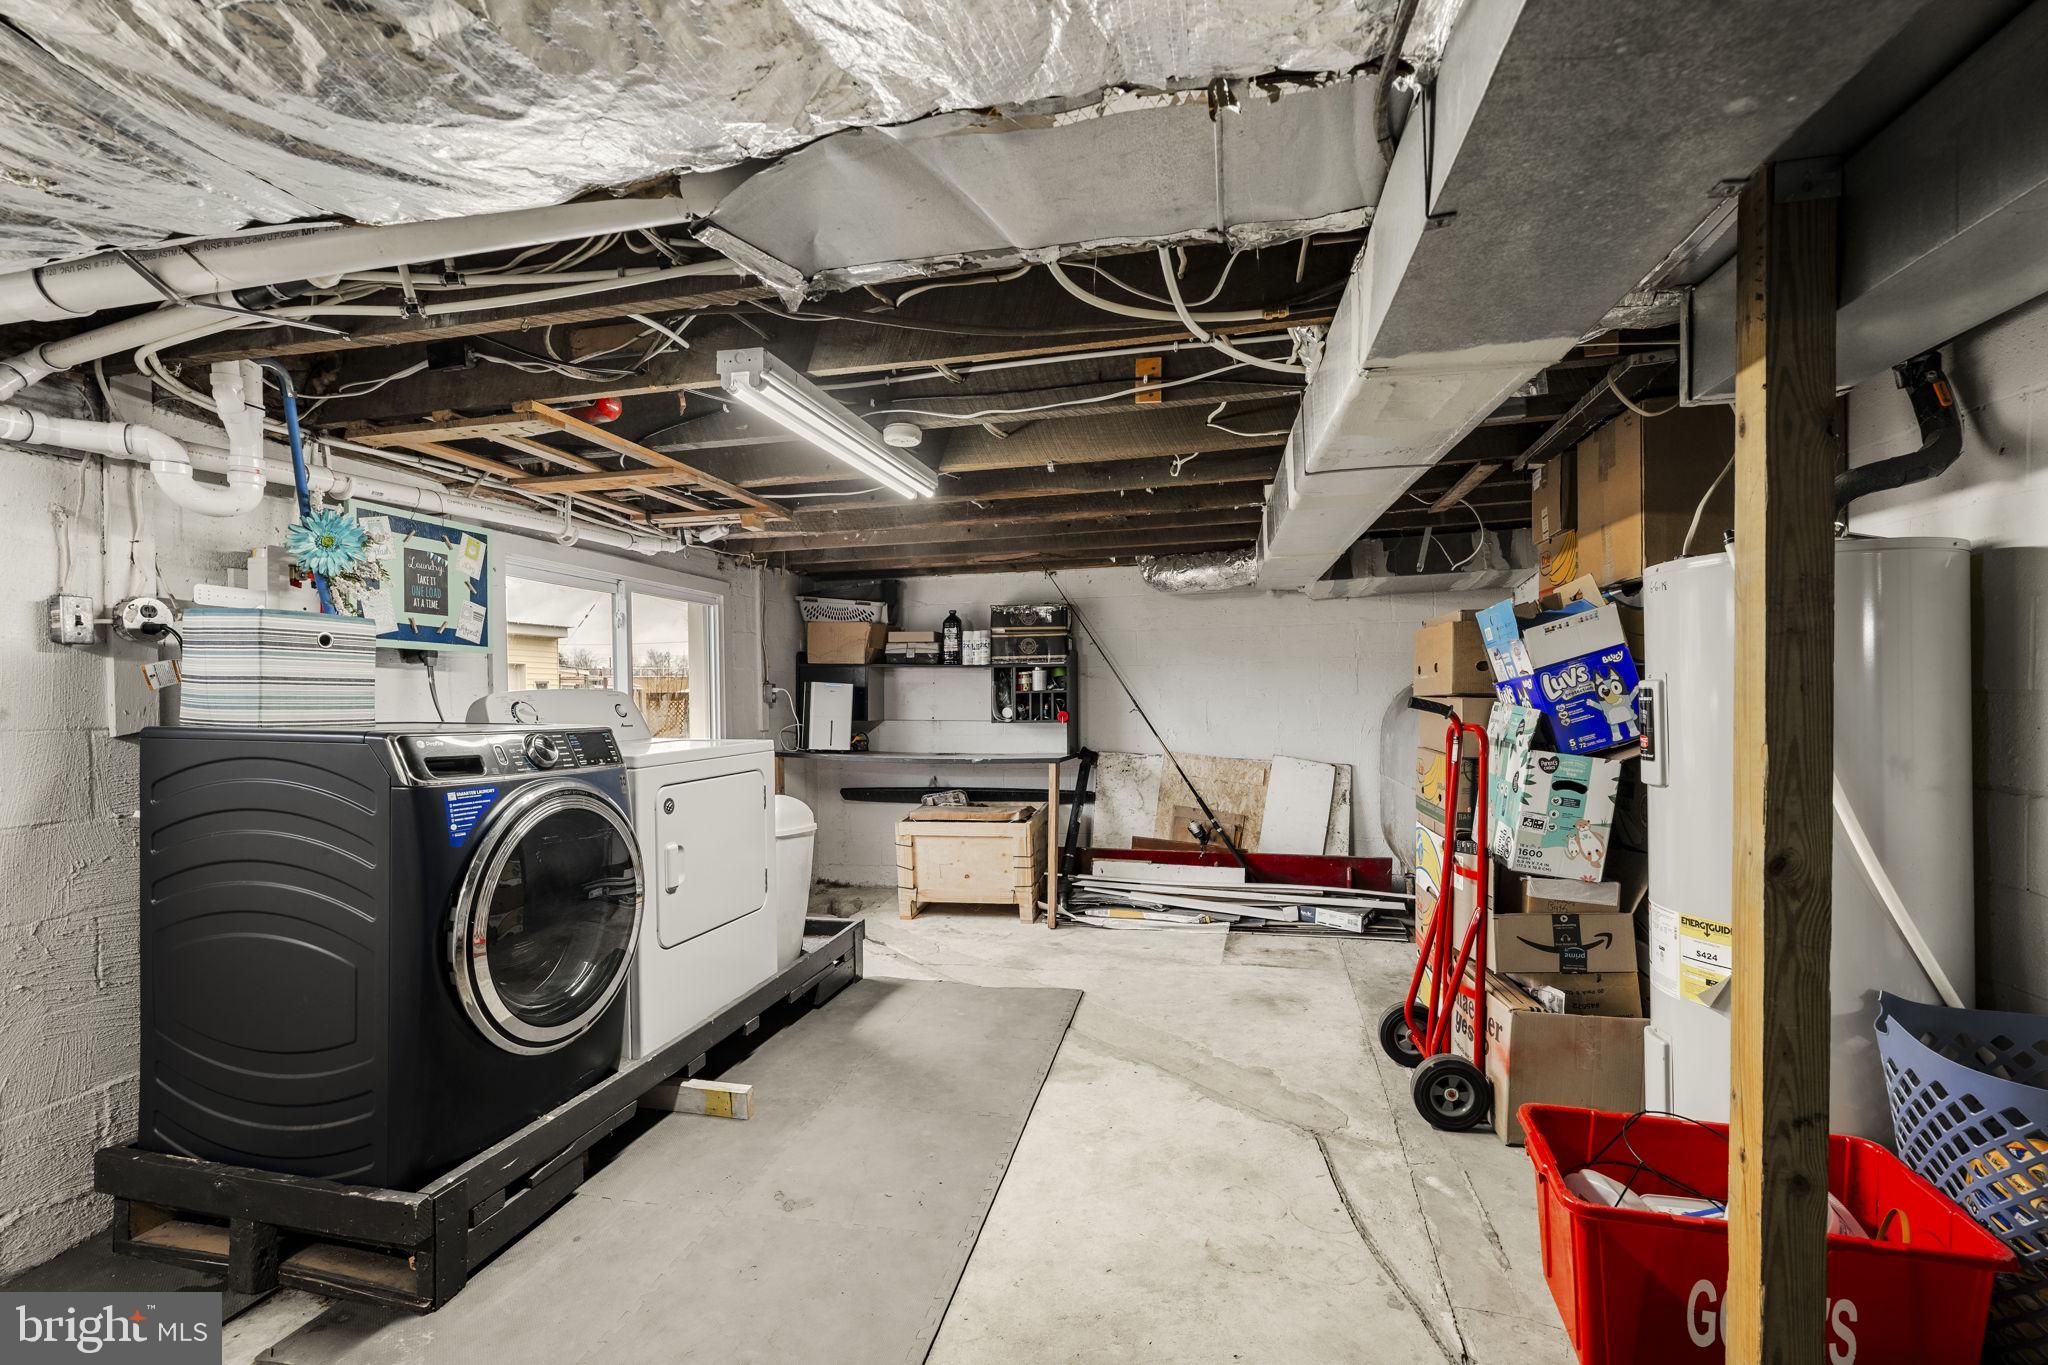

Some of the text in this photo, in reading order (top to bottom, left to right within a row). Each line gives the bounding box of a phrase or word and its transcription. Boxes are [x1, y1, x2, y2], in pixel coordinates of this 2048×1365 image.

[417, 573, 430, 585] TAKE
[411, 584, 442, 599] ONE LOAD
[1541, 665, 1589, 701] Luvs
[1518, 847, 1543, 858] 1600
[1564, 952, 1586, 960] prime
